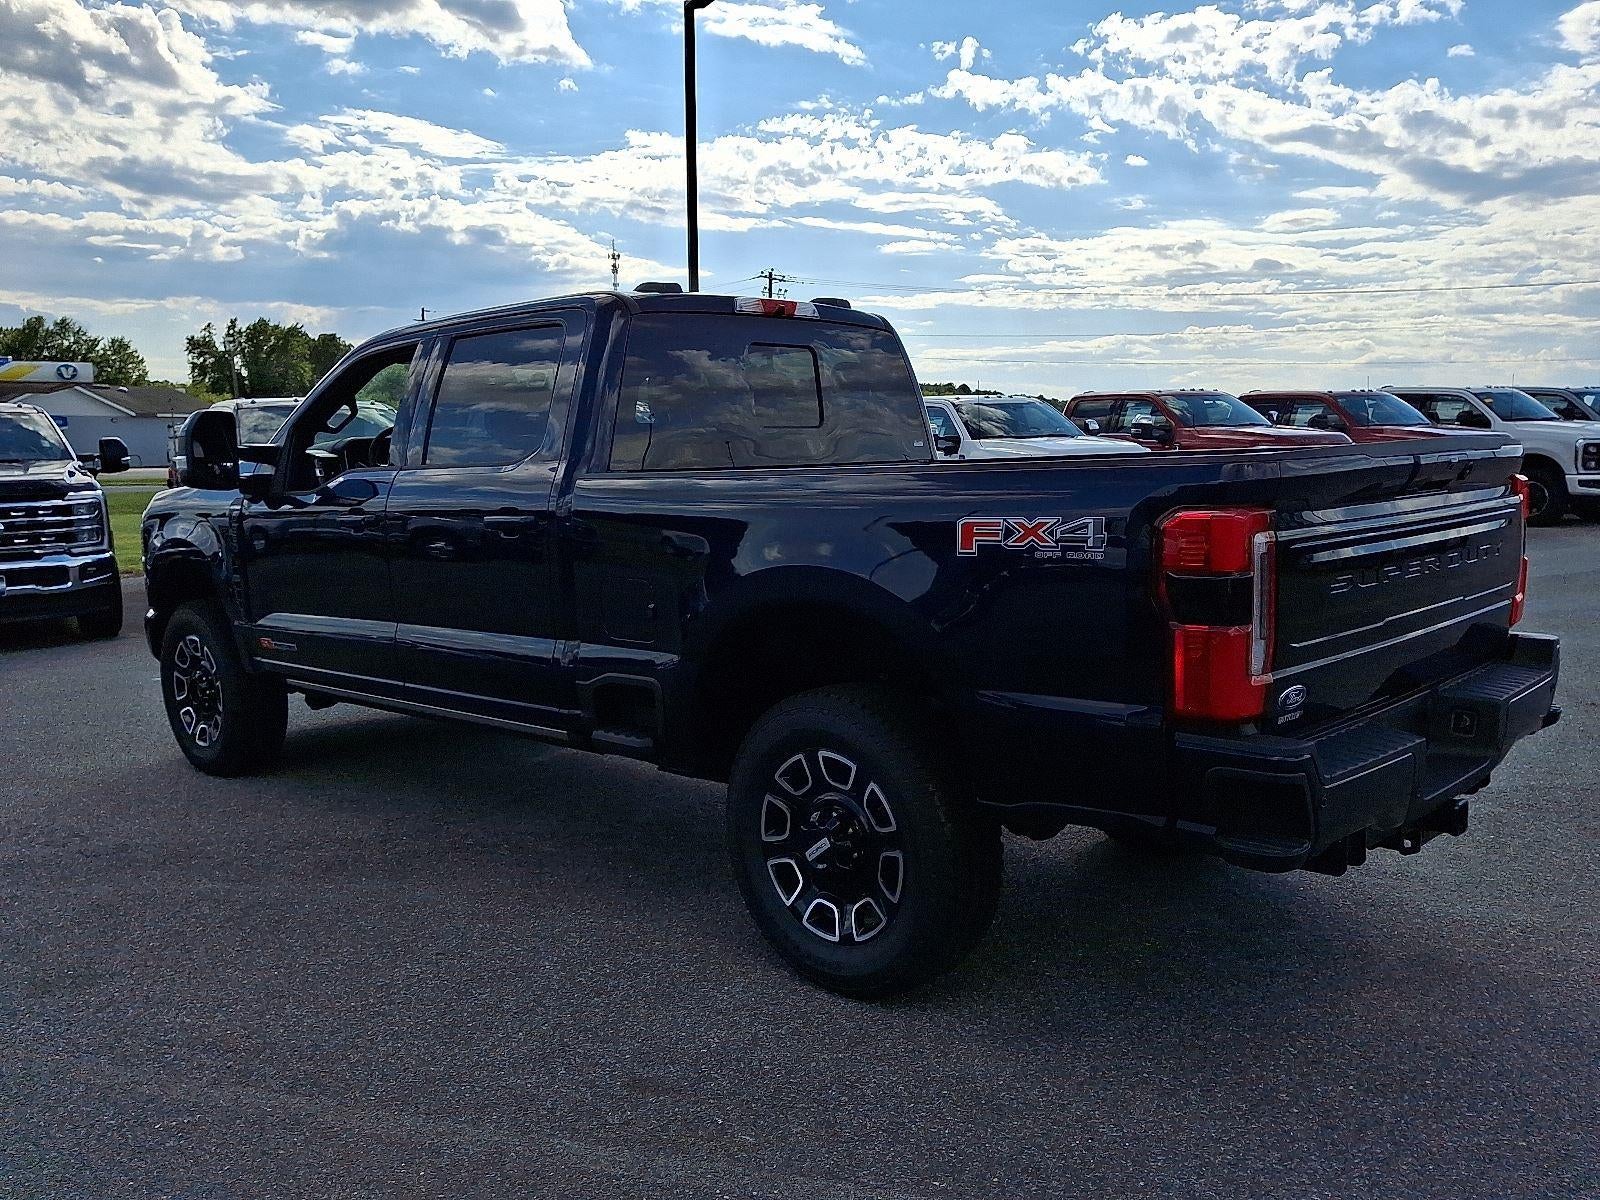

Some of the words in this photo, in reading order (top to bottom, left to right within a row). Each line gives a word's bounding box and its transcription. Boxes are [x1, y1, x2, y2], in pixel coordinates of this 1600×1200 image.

[957, 517, 1107, 556] FX4
[1034, 551, 1062, 559] OFF
[1066, 551, 1105, 560] ROAD
[1329, 557, 1441, 594] SUPER
[1447, 539, 1503, 569] DUTY
